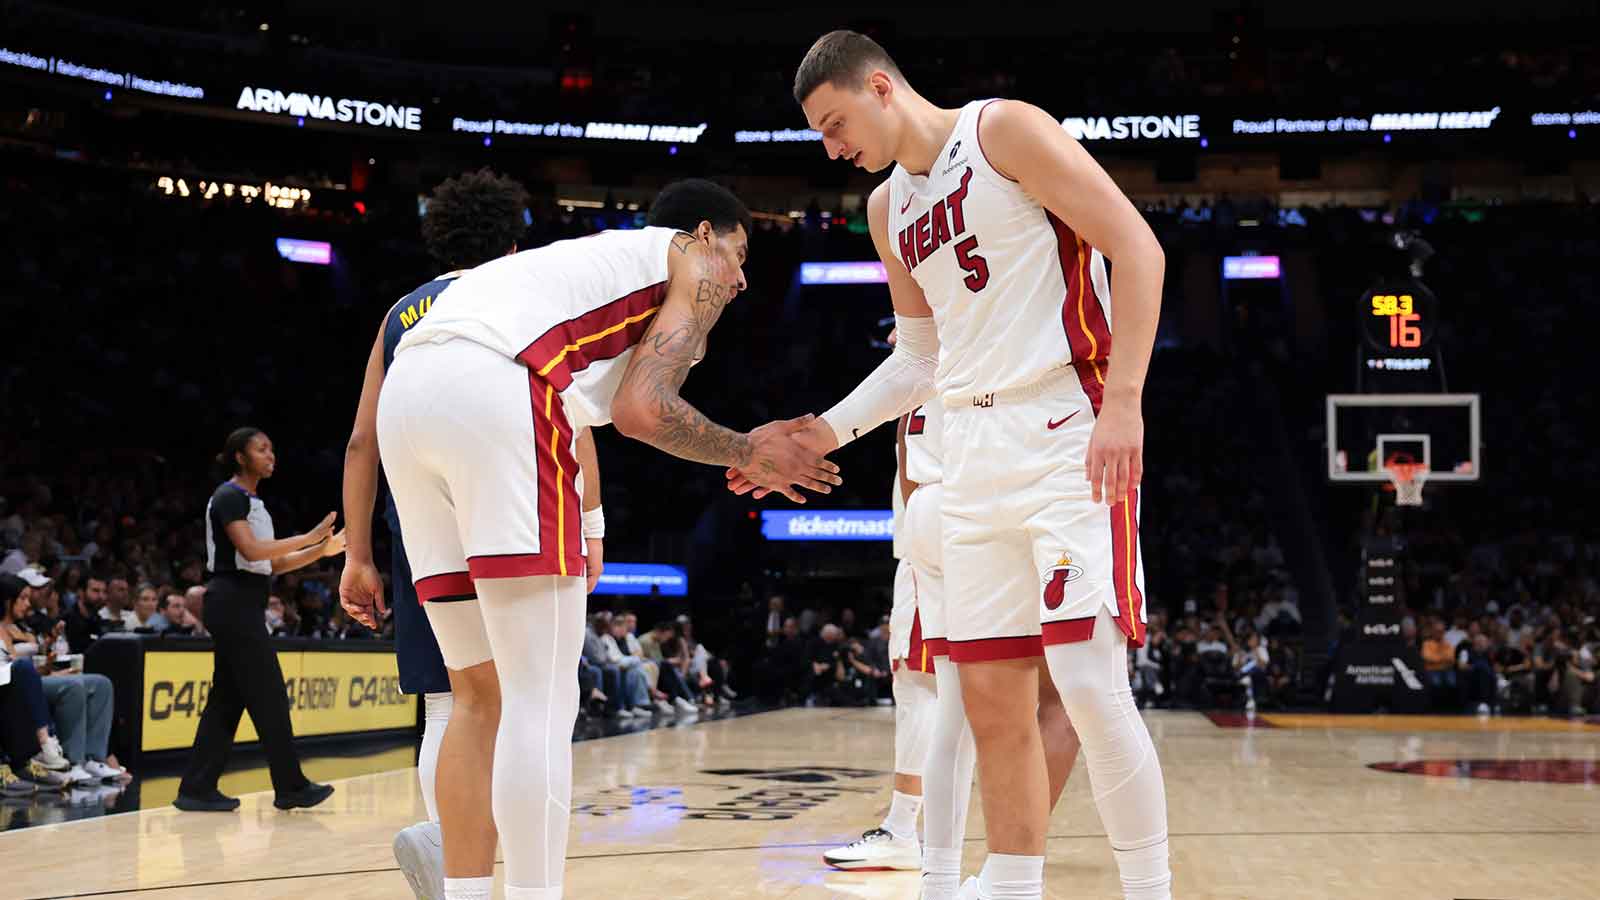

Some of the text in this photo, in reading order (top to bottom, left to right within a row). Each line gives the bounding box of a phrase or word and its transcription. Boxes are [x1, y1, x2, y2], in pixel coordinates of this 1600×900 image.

[453, 118, 707, 143] Proud Partner of the MIAMI HEAT
[1233, 107, 1500, 133] Proud Partner of the MIAMI HEAT
[898, 166, 973, 273] HEAT
[954, 234, 990, 293] 5
[1372, 295, 1413, 316] 58.3
[1389, 313, 1421, 348] 16
[150, 681, 195, 720] C4
[298, 677, 338, 710] ENERGY
[349, 676, 378, 708] C4
